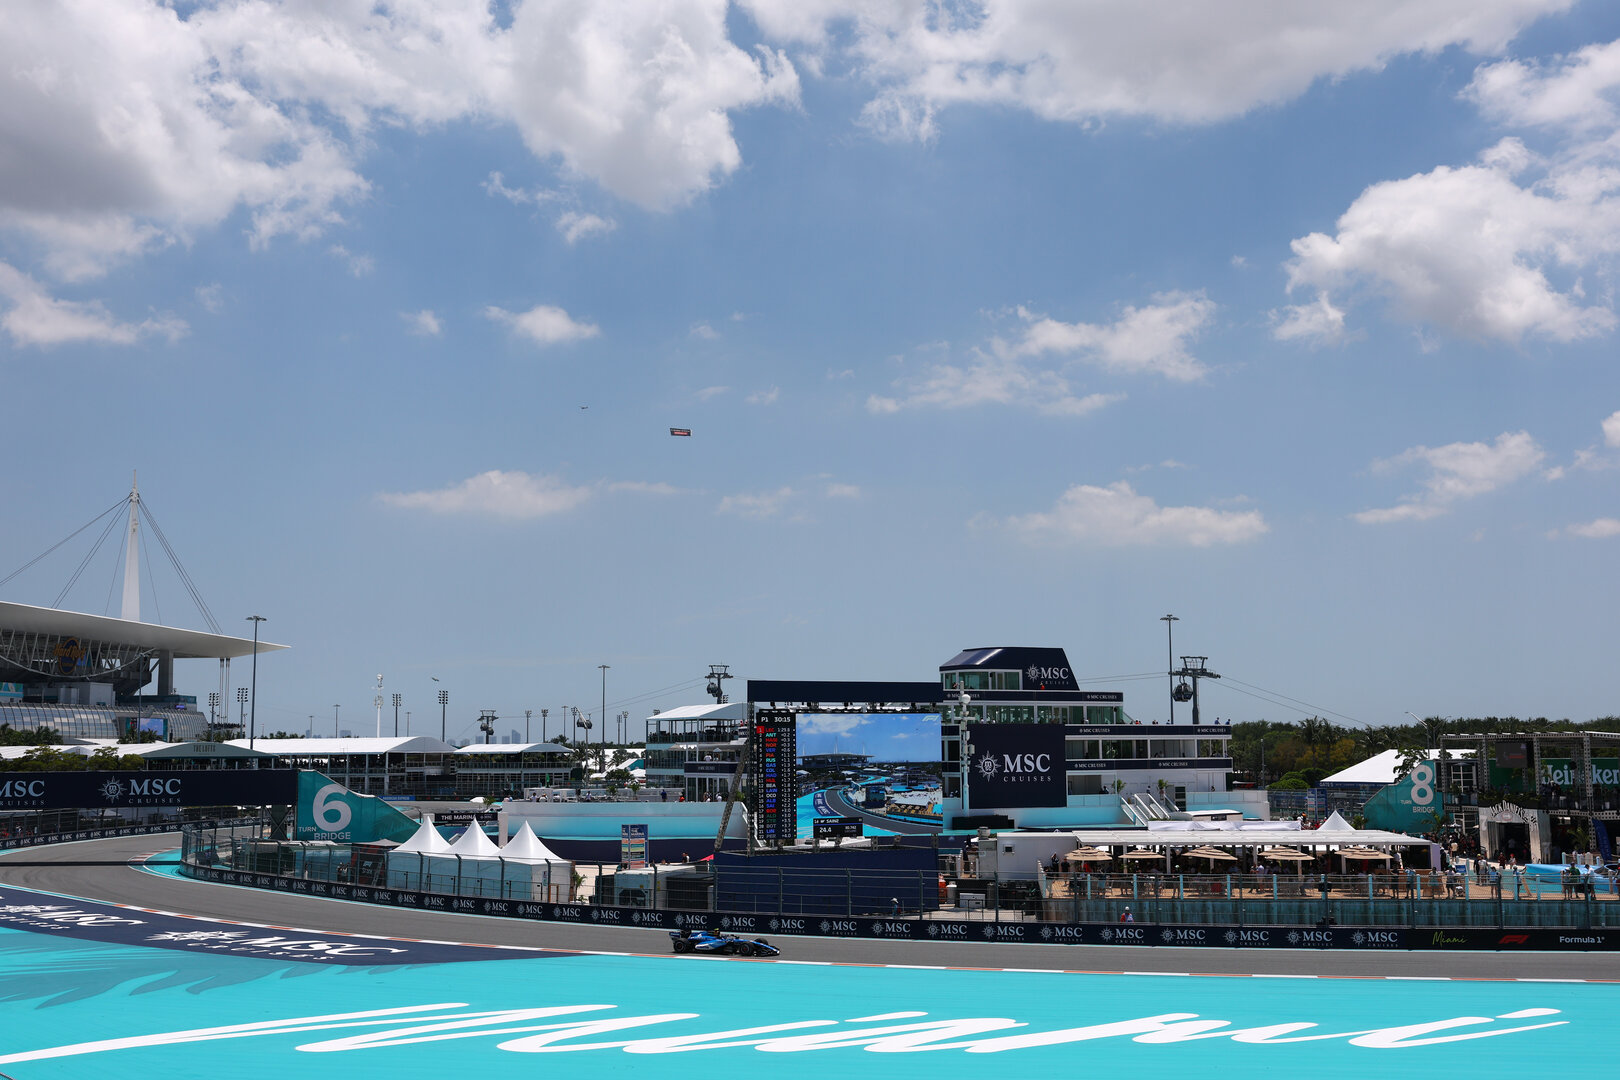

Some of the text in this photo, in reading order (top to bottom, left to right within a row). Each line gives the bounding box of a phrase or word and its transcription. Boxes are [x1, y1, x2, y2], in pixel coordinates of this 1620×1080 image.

[1040, 667, 1069, 679] MSC
[1003, 754, 1050, 772] MSC
[129, 779, 181, 795] MSC
[1411, 764, 1433, 805] 8
[313, 784, 351, 832] 6
[1490, 802, 1504, 817] JACK
[314, 832, 351, 840] BRIDGE
[316, 884, 326, 892] MSC
[336, 887, 347, 895] MSC
[357, 889, 368, 897] MSC
[380, 892, 391, 900] MSC
[403, 894, 416, 903] MSC
[430, 897, 445, 906] MSC
[460, 900, 475, 908] MSC
[491, 902, 508, 912] MSC
[525, 904, 543, 914] MSC
[562, 907, 580, 917] MSC
[22, 910, 148, 926] MSC
[601, 910, 620, 919] MSC
[642, 913, 662, 922] MSC
[685, 915, 707, 924] MSC
[732, 917, 756, 927] MSC
[781, 919, 805, 929] MSC
[832, 921, 857, 931] MSC
[885, 923, 911, 932] MSC
[940, 924, 967, 934] MSC
[997, 926, 1024, 936] MSC
[1055, 927, 1082, 937] MSC
[1116, 929, 1144, 939] MSC
[1176, 930, 1206, 940] MSC
[1239, 931, 1269, 941] MSC
[1302, 931, 1333, 941] MSC
[1368, 932, 1398, 942] MSC
[1432, 931, 1468, 946] Miami
[1500, 935, 1529, 944] F1
[187, 942, 335, 960] CRUISES
[218, 937, 408, 956] MSC
